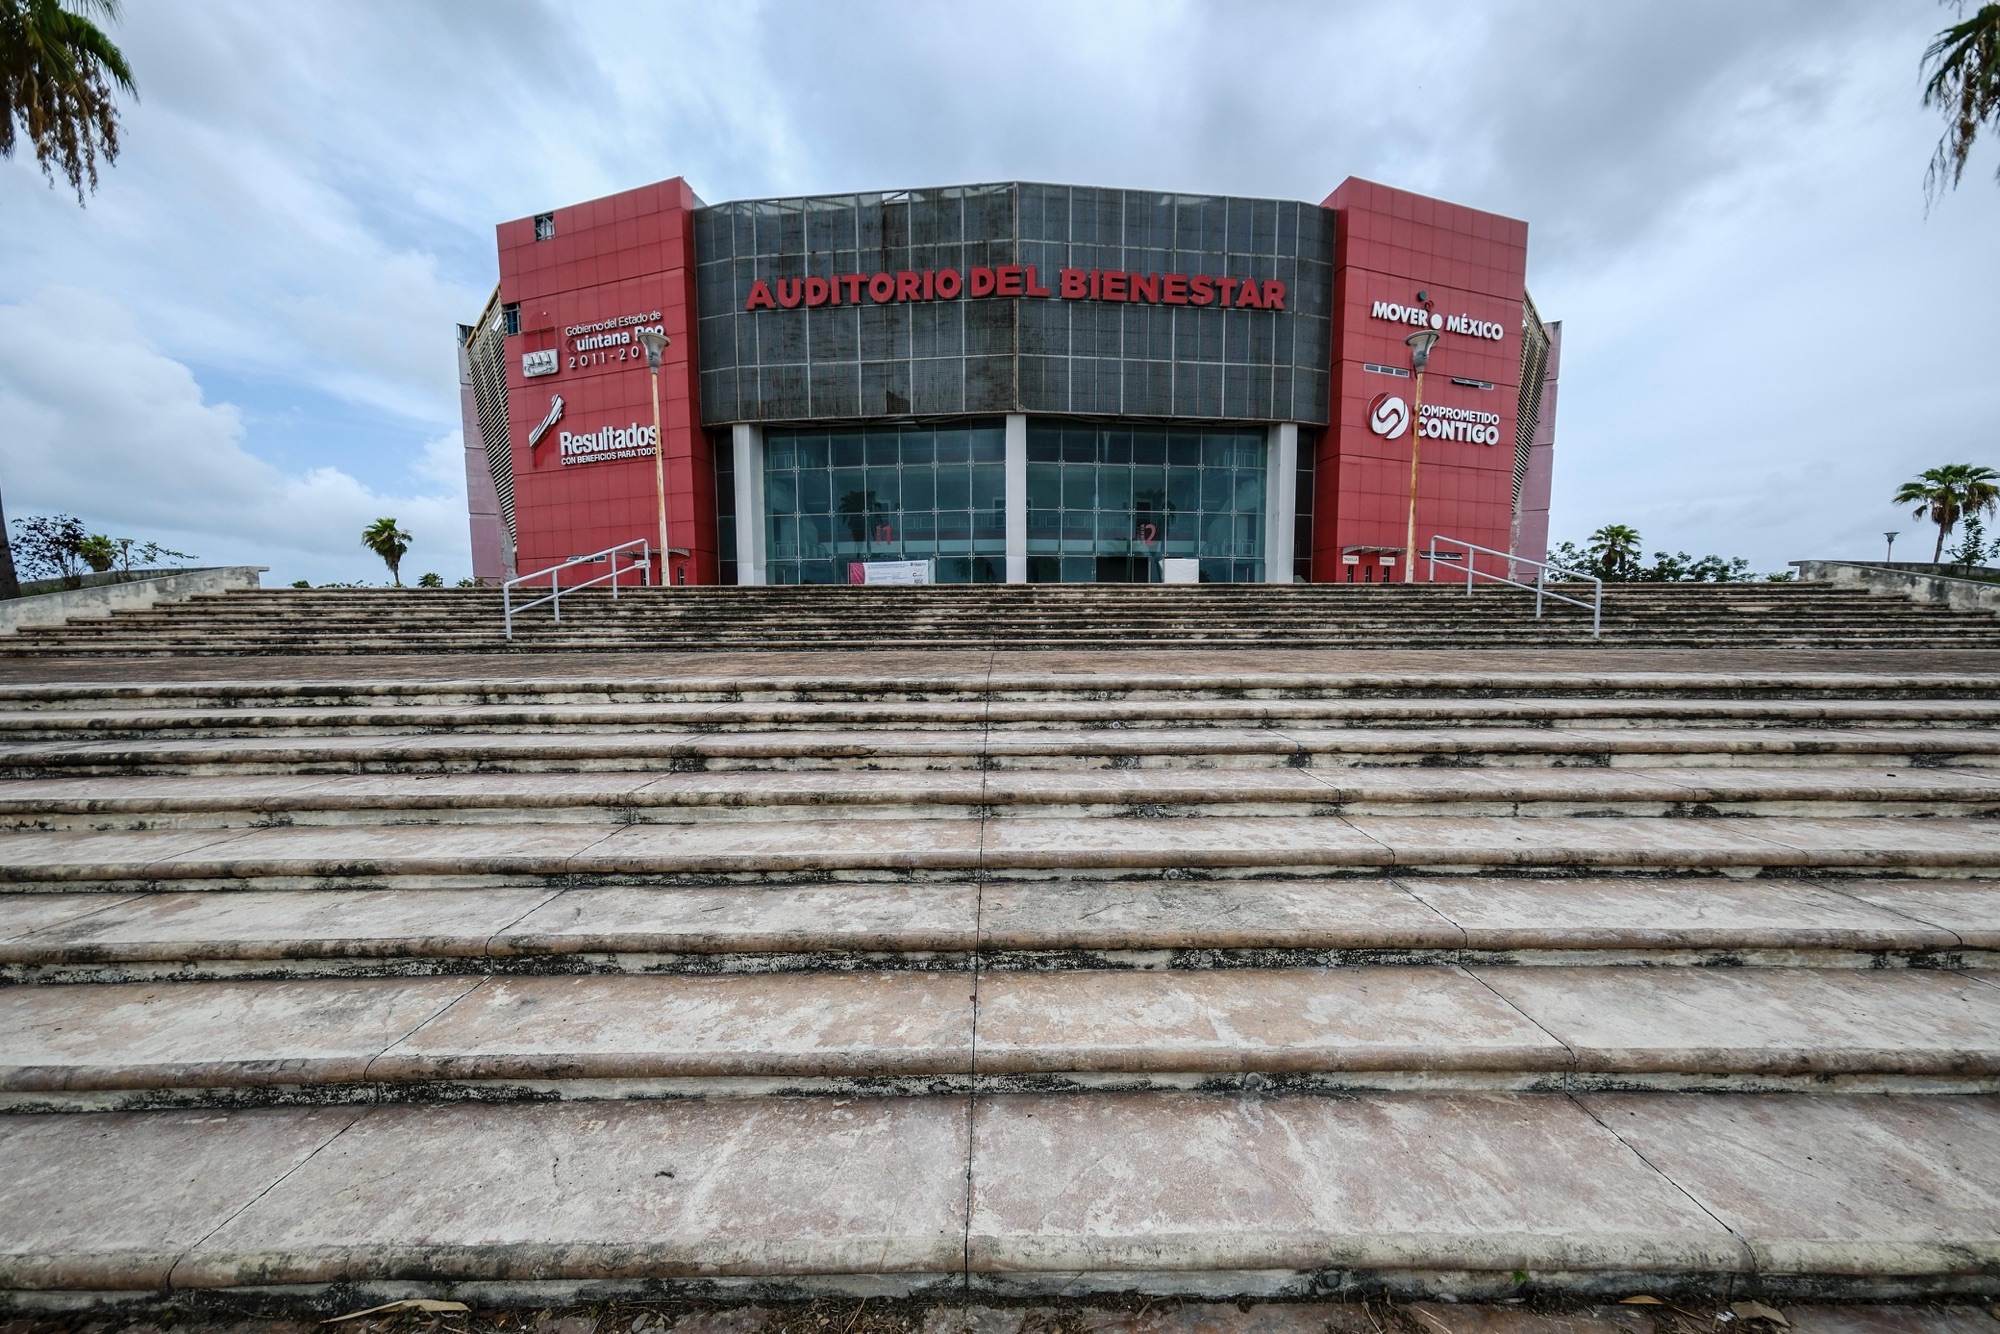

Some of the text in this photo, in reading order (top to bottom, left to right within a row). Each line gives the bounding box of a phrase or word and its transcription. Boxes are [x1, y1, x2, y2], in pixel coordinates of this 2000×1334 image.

[745, 265, 1286, 310] AUDITORIO DEL BIENESTAR
[565, 311, 661, 337] Gobierno del Estado de
[1372, 301, 1504, 341] MOVER MÉXICO
[566, 331, 630, 352] uintana
[560, 422, 659, 456] Resultados
[1417, 416, 1499, 446] CONTIGO
[561, 447, 659, 465] CON BENEFICIOS PARA TODO
[1145, 524, 1156, 545] 2
